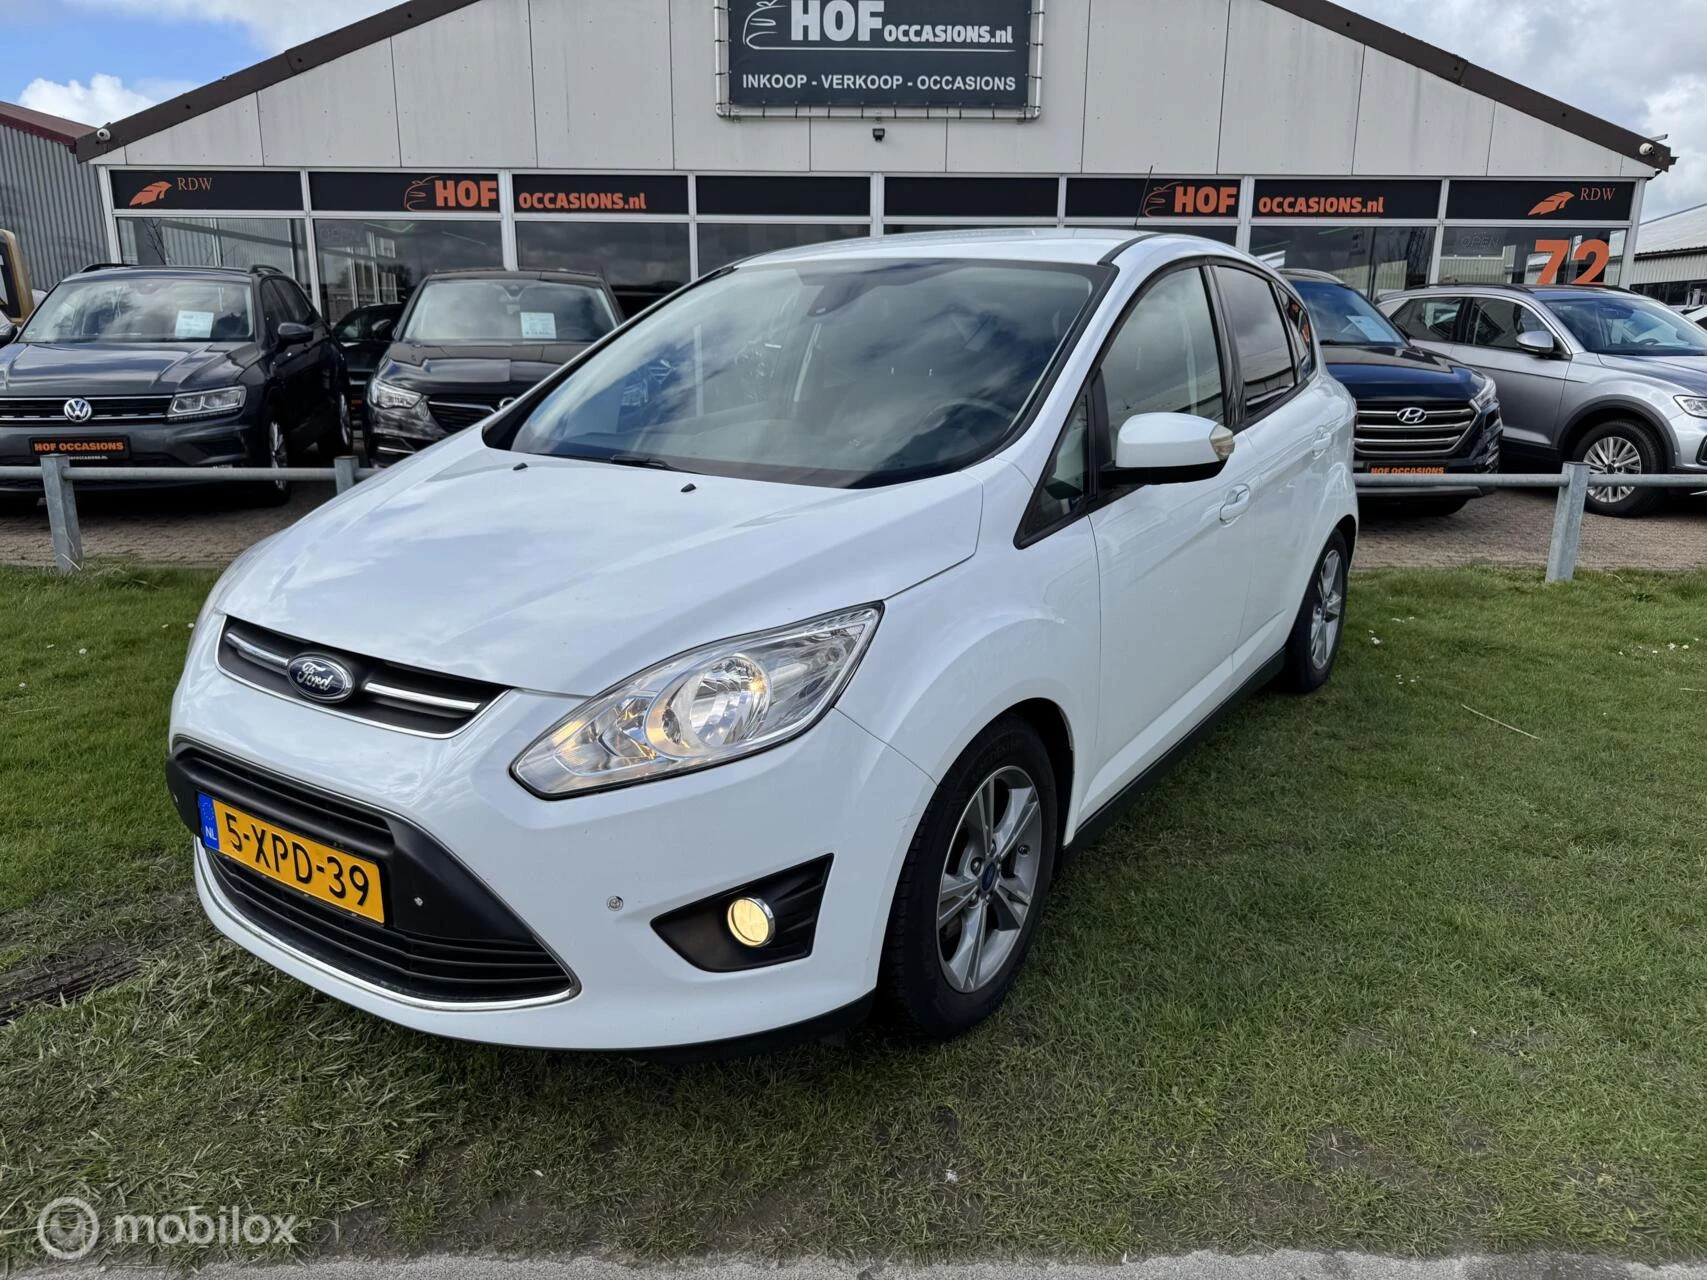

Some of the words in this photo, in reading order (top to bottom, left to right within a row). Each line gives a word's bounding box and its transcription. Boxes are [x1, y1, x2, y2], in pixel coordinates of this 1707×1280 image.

[790, 0, 885, 42] HOF
[884, 24, 1013, 44] OCCASIONS.nl
[742, 73, 807, 89] INKOOP
[821, 74, 903, 90] VERKOOP
[917, 75, 1016, 91] OCCASIONS
[176, 177, 213, 191] RDW
[434, 180, 497, 208] HOF
[518, 191, 646, 210] OCCASIONS.nl
[1580, 187, 1616, 201] RDW
[1173, 186, 1237, 215] HOF
[1258, 196, 1384, 215] OCCASIONS.nl
[1535, 239, 1610, 285] 72
[34, 442, 57, 451] HOF
[59, 441, 124, 451] OCCASIONS
[296, 662, 335, 692] Ford
[205, 826, 217, 841] NL
[225, 812, 370, 906] 5-XPD-39
